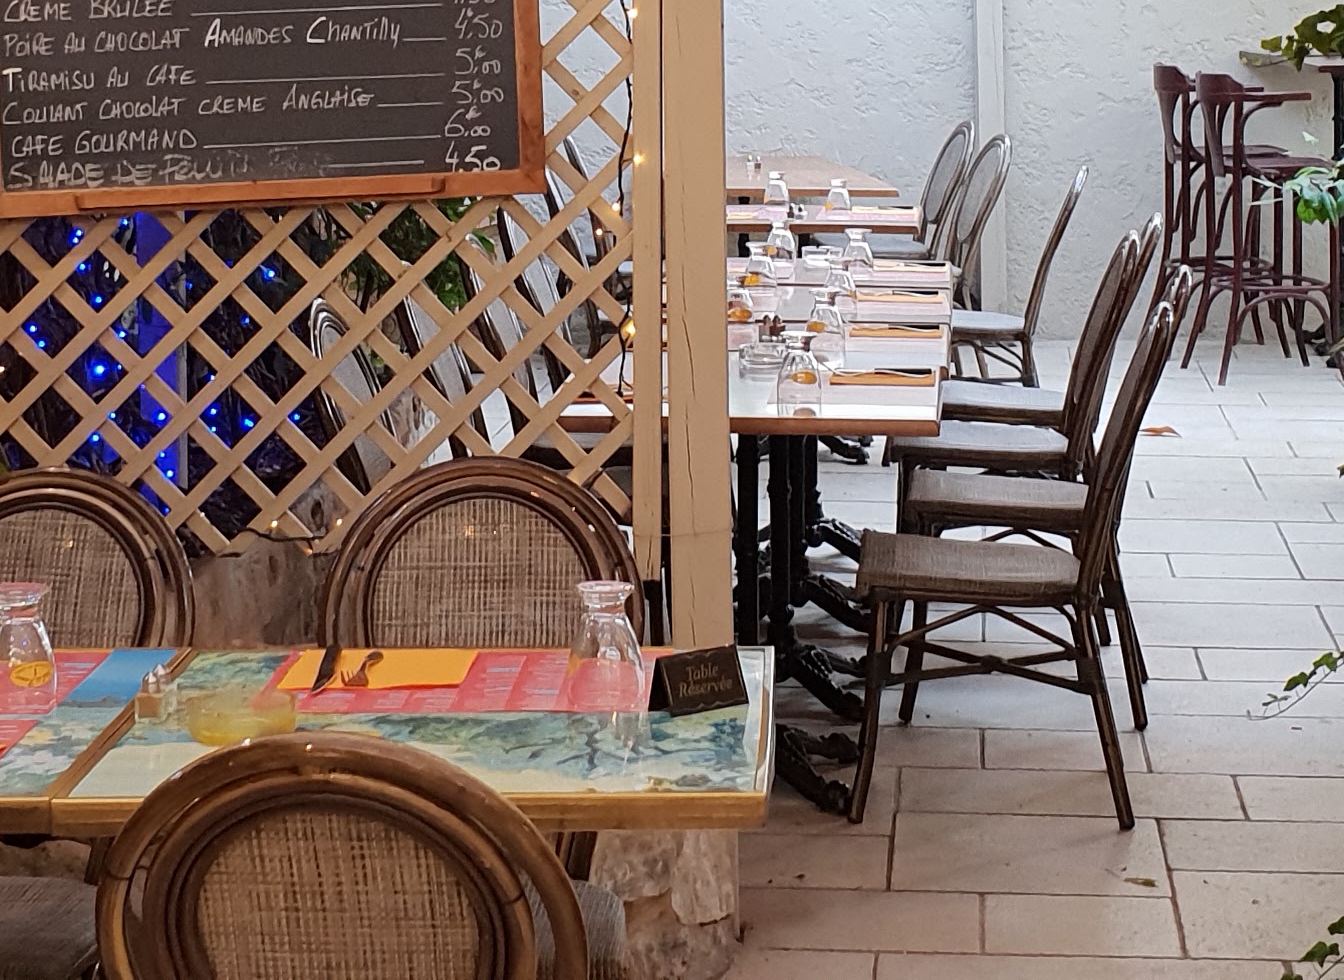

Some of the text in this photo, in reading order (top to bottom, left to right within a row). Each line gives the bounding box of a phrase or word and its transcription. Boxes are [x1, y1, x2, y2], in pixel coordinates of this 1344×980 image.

[64, 32, 86, 53] AU
[94, 28, 190, 53] CHOCOLAT
[106, 66, 129, 87] AU
[146, 63, 197, 86] CAFE
[2, 102, 88, 125] COULANT
[99, 96, 187, 120] CHOCOLAT
[198, 94, 266, 115] CREME
[11, 134, 64, 157] CAFE
[75, 129, 198, 154] GOURMAND
[7, 161, 105, 188] SALADE
[112, 161, 157, 186] DE
[685, 662, 719, 681] Table
